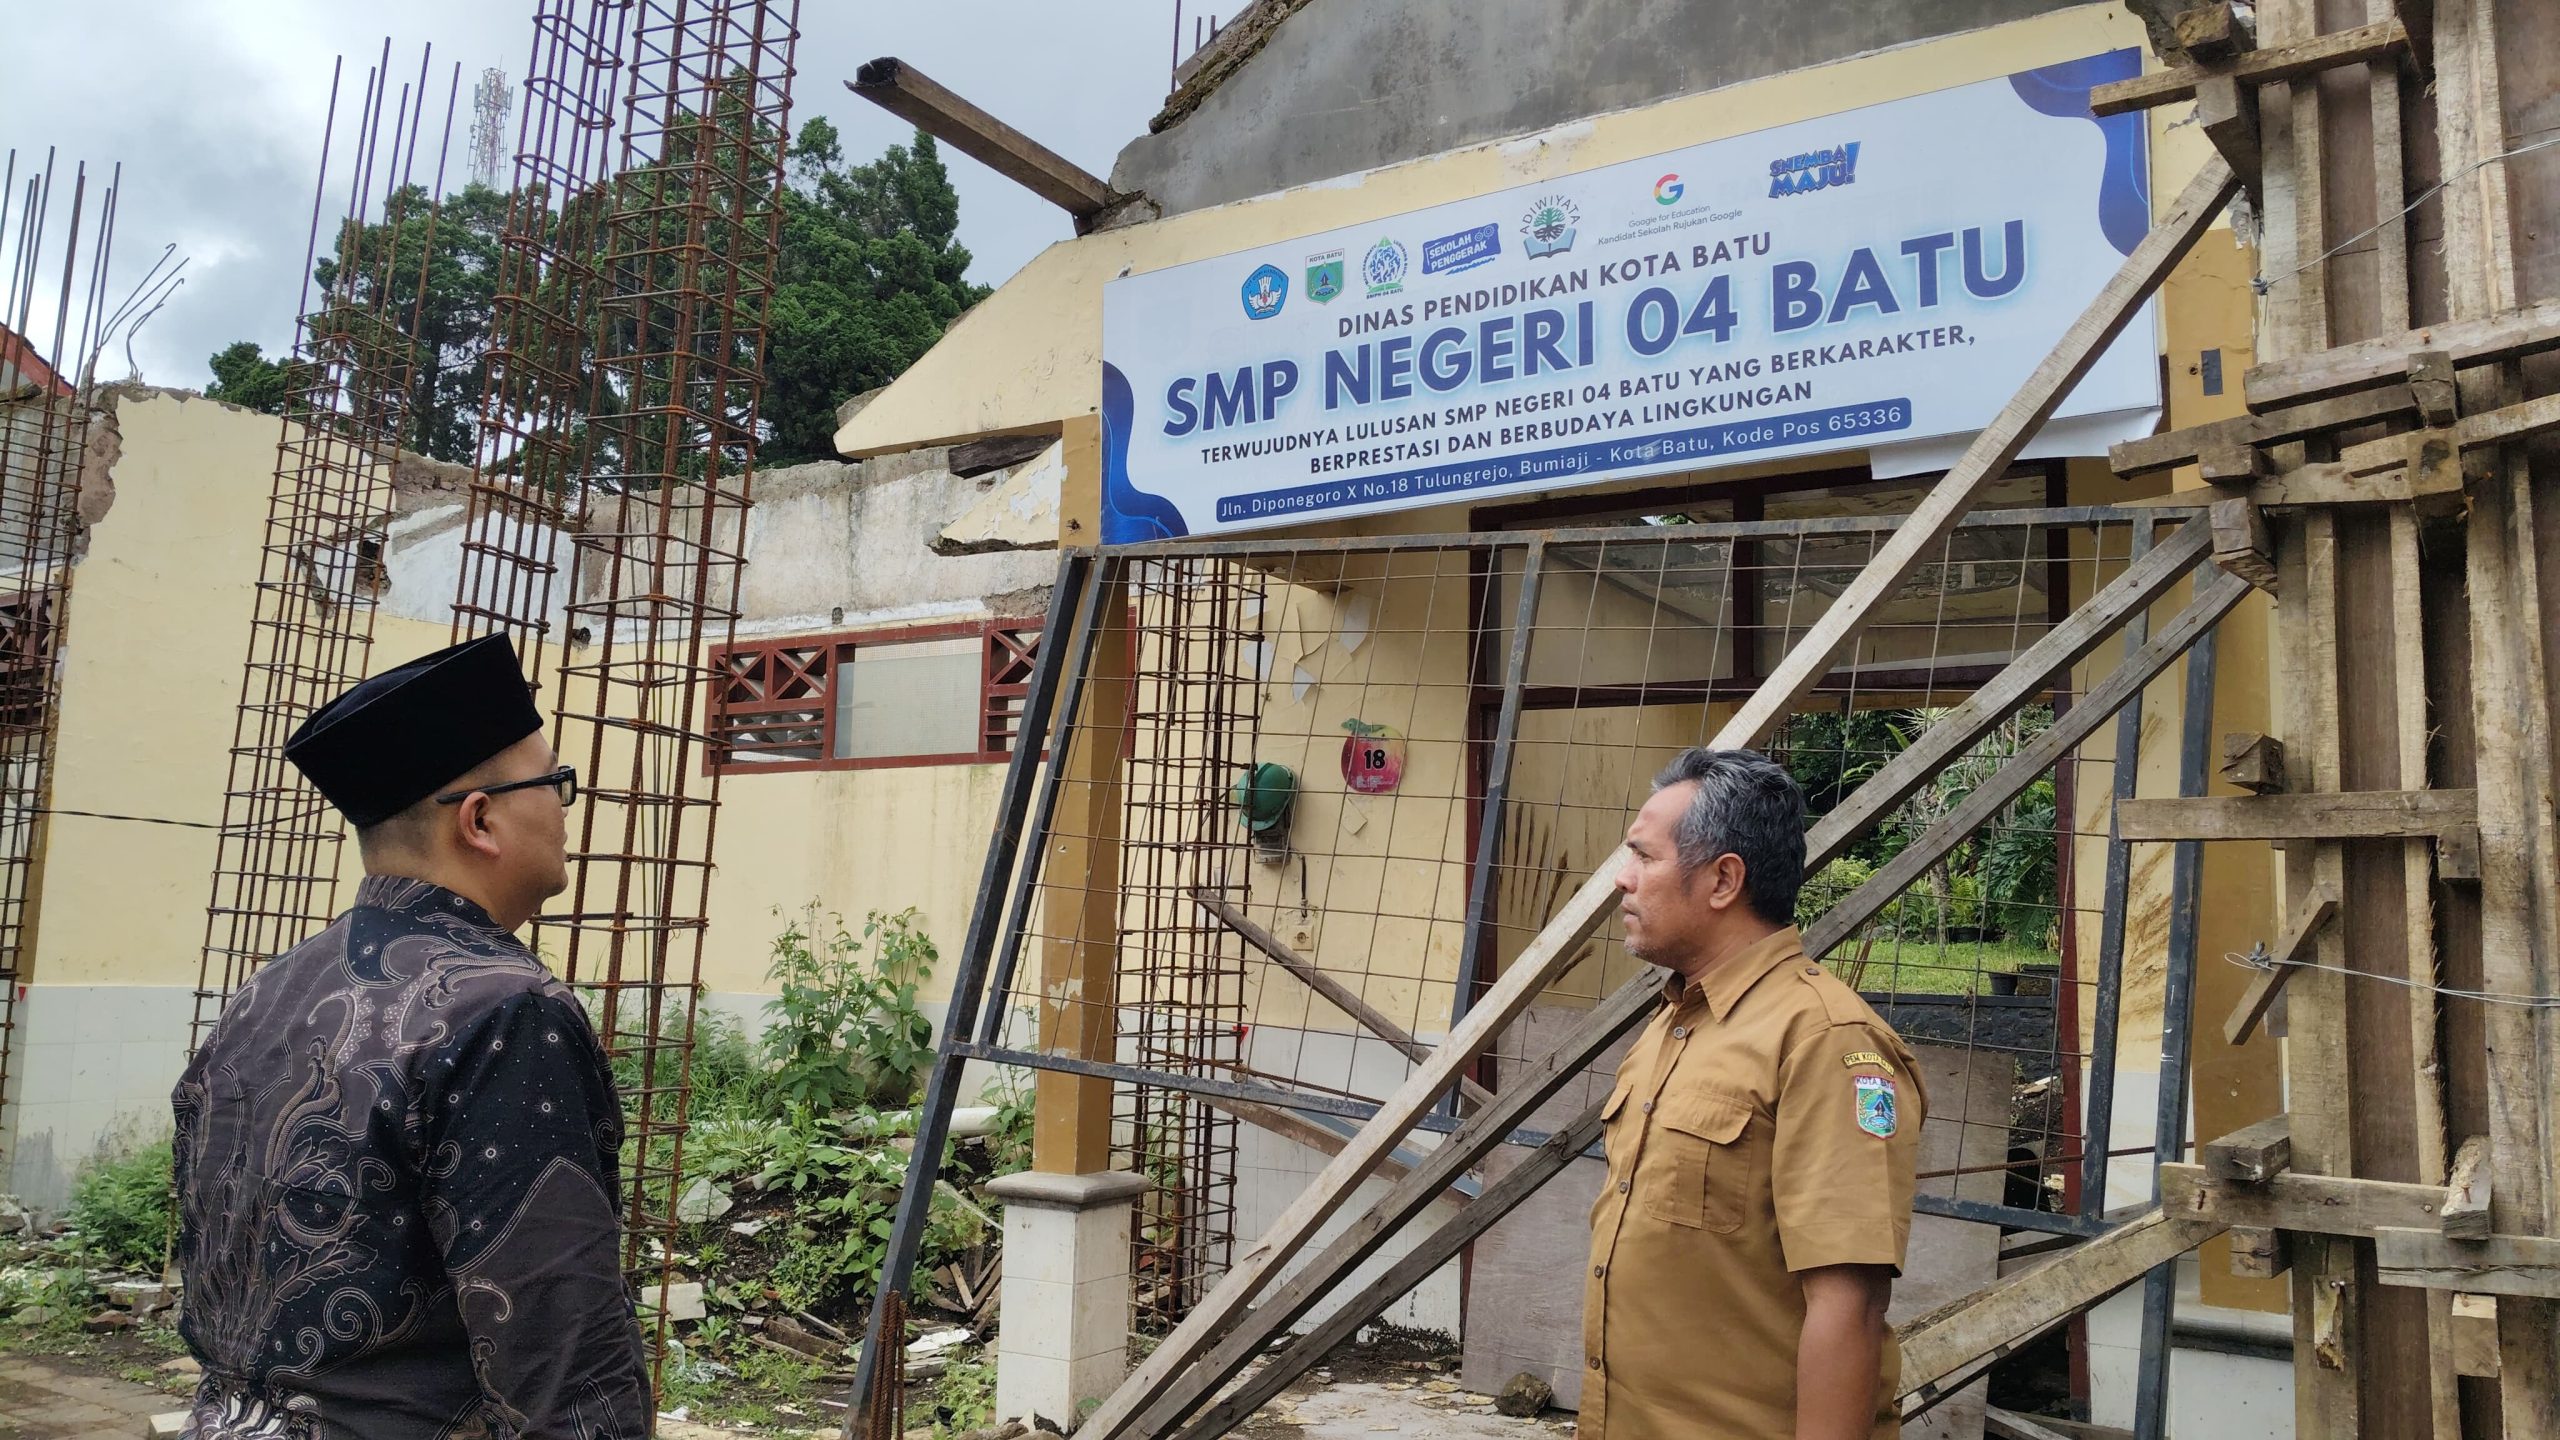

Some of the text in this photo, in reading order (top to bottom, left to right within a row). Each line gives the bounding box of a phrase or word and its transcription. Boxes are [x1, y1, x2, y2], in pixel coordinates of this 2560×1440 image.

[1519, 195, 1581, 235] ADIWIYATA
[1597, 208, 1743, 246] Kandidat Sekolah Rujukan Google
[1628, 205, 1711, 229] Google for Education
[1309, 251, 1343, 263] KOTA BATU
[1429, 233, 1472, 260] SEKOLAH
[1430, 240, 1488, 271] PENGGERAK
[1338, 231, 1772, 338] DINAS PENDIDIKAN KOTA BATU
[1163, 219, 2025, 437] SMP NEGERI 04 BATU
[1201, 325, 1976, 465] TERWUJUDNYA LULUSAN SMP NEGERI 04 BATU YANG BERKARAKTER,
[1310, 381, 1812, 475] BERPRESTASI DAN BERBUDAYA LINGKUNGAN
[1221, 502, 1247, 517] Jln.
[1252, 490, 1341, 513] Diponegoro
[1347, 485, 1357, 499] X
[1363, 479, 1408, 497] No.18
[1414, 465, 1513, 493] Tulungrejo,
[1520, 451, 1590, 477] Bumiaji
[1610, 445, 1656, 462] Kota
[1662, 436, 1714, 455] Batu,
[1723, 427, 1775, 447] Kode
[1782, 419, 1820, 438] Pos
[1829, 407, 1901, 432] 65336
[1364, 749, 1386, 769] 18
[1856, 1077, 1878, 1085] KOTA
